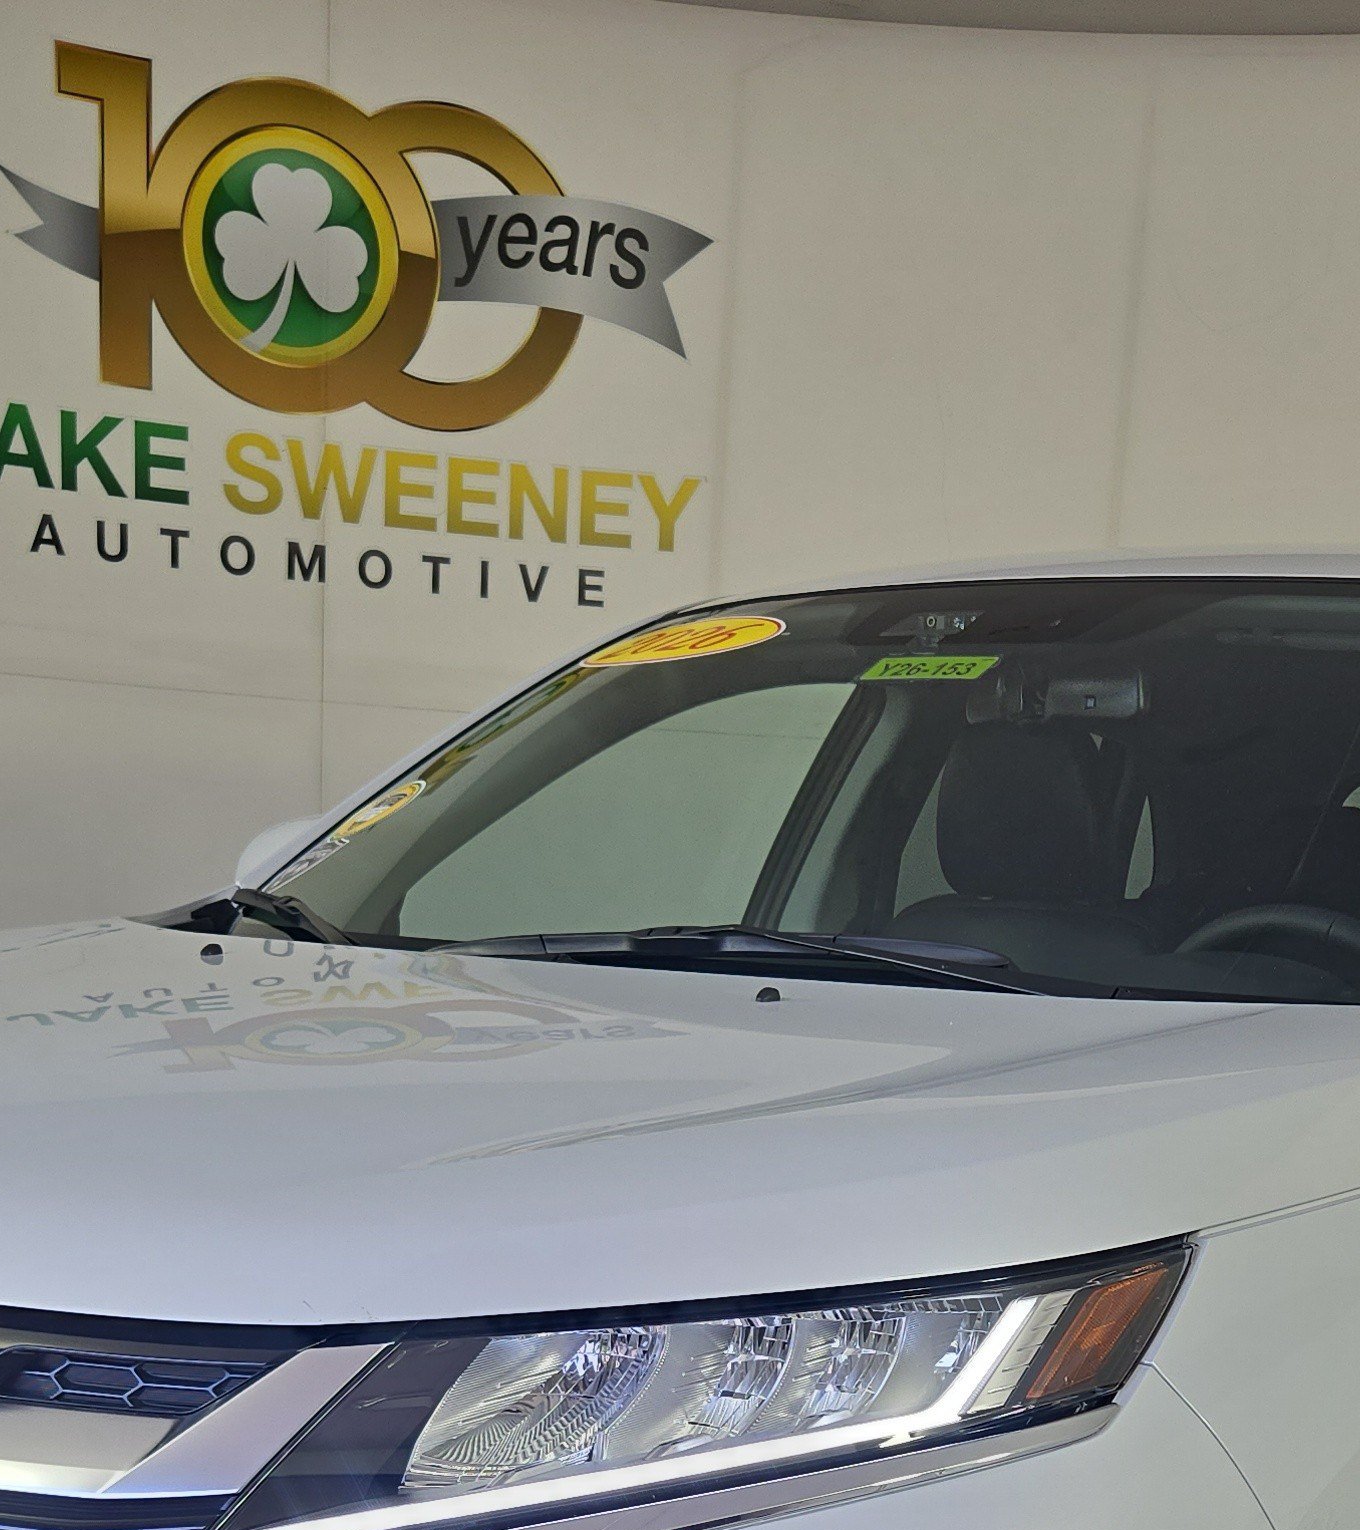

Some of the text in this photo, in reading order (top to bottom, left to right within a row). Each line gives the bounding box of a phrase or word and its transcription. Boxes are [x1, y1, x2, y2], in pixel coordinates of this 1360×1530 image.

[54, 40, 584, 431] 100
[454, 211, 651, 290] years
[222, 432, 706, 552] SWEENEY
[30, 513, 606, 608] AUTOMOTIVE
[878, 662, 978, 677] Y26-153
